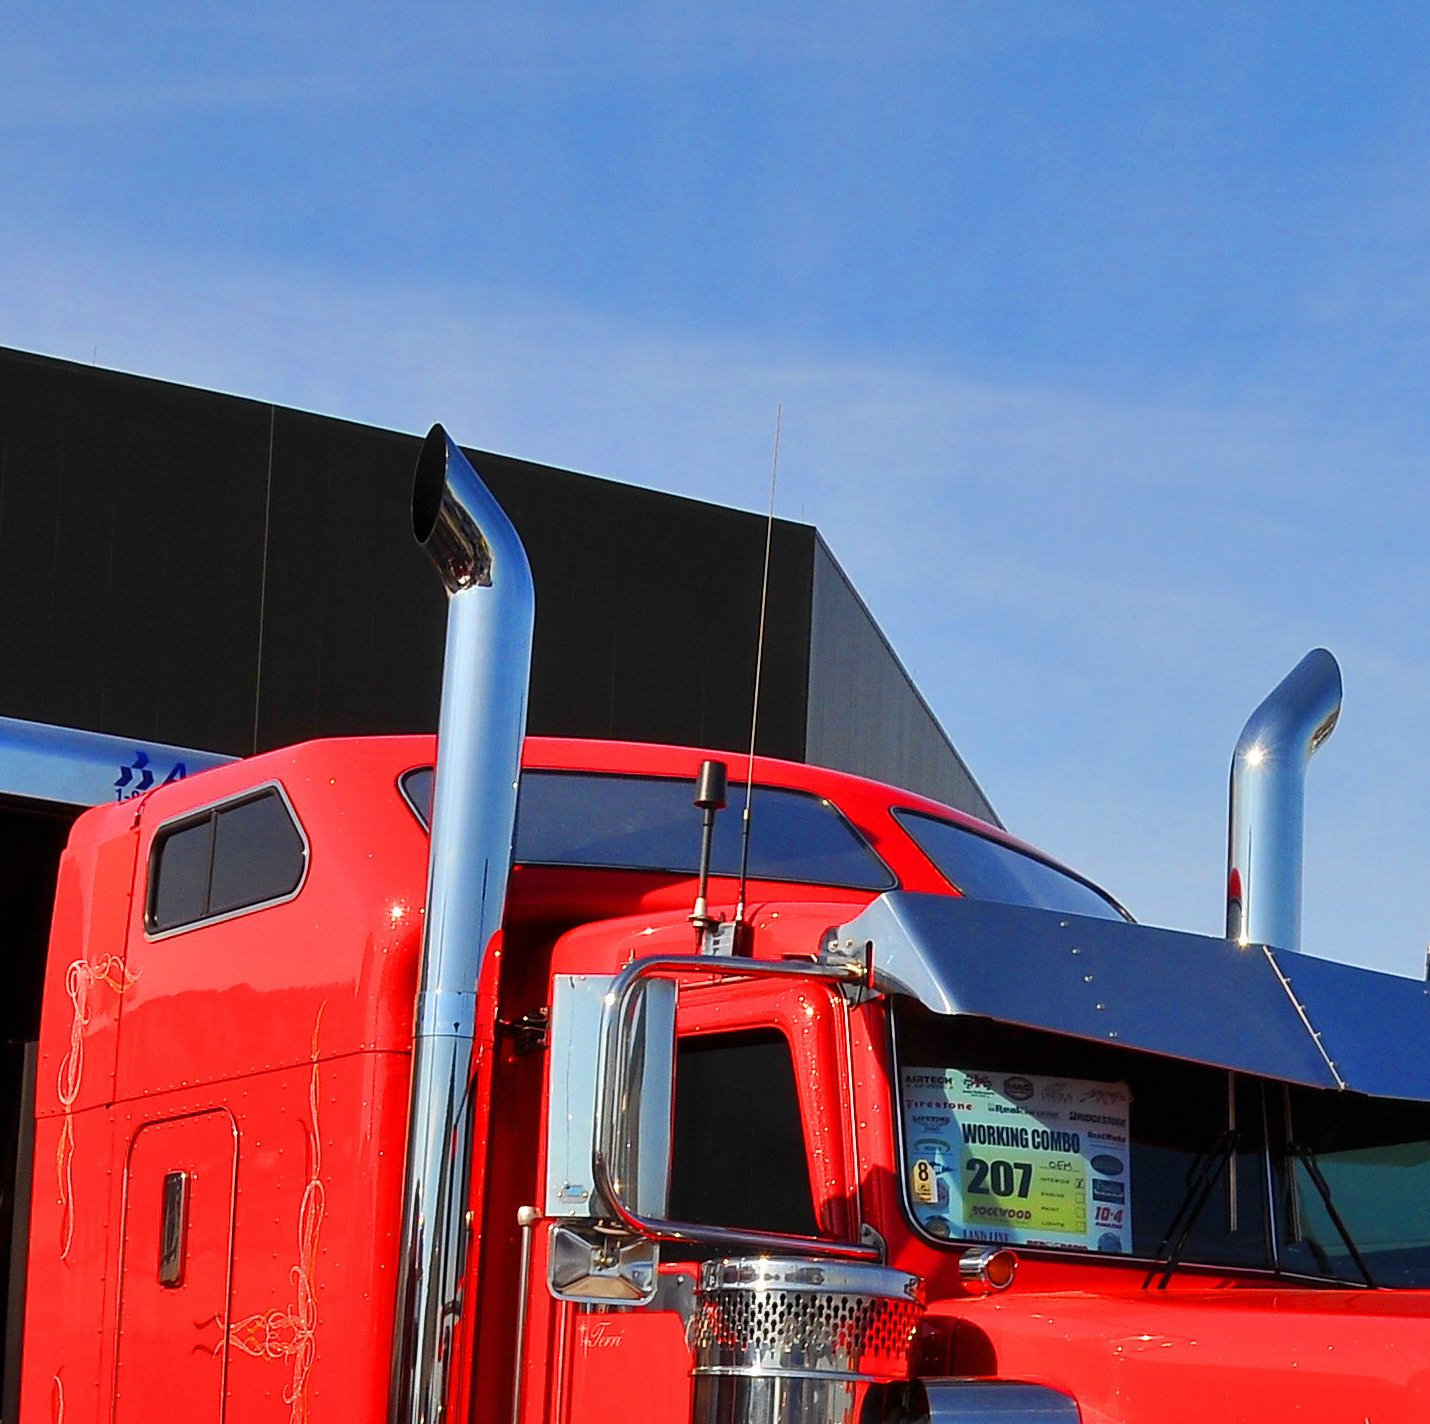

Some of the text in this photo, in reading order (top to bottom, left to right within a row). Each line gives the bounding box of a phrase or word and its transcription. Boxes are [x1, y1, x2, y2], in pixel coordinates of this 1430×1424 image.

[906, 1100, 973, 1111] Firestone
[962, 1123, 1080, 1154] WORKING COMBO
[918, 1162, 929, 1181] 8
[966, 1158, 1032, 1198] 207
